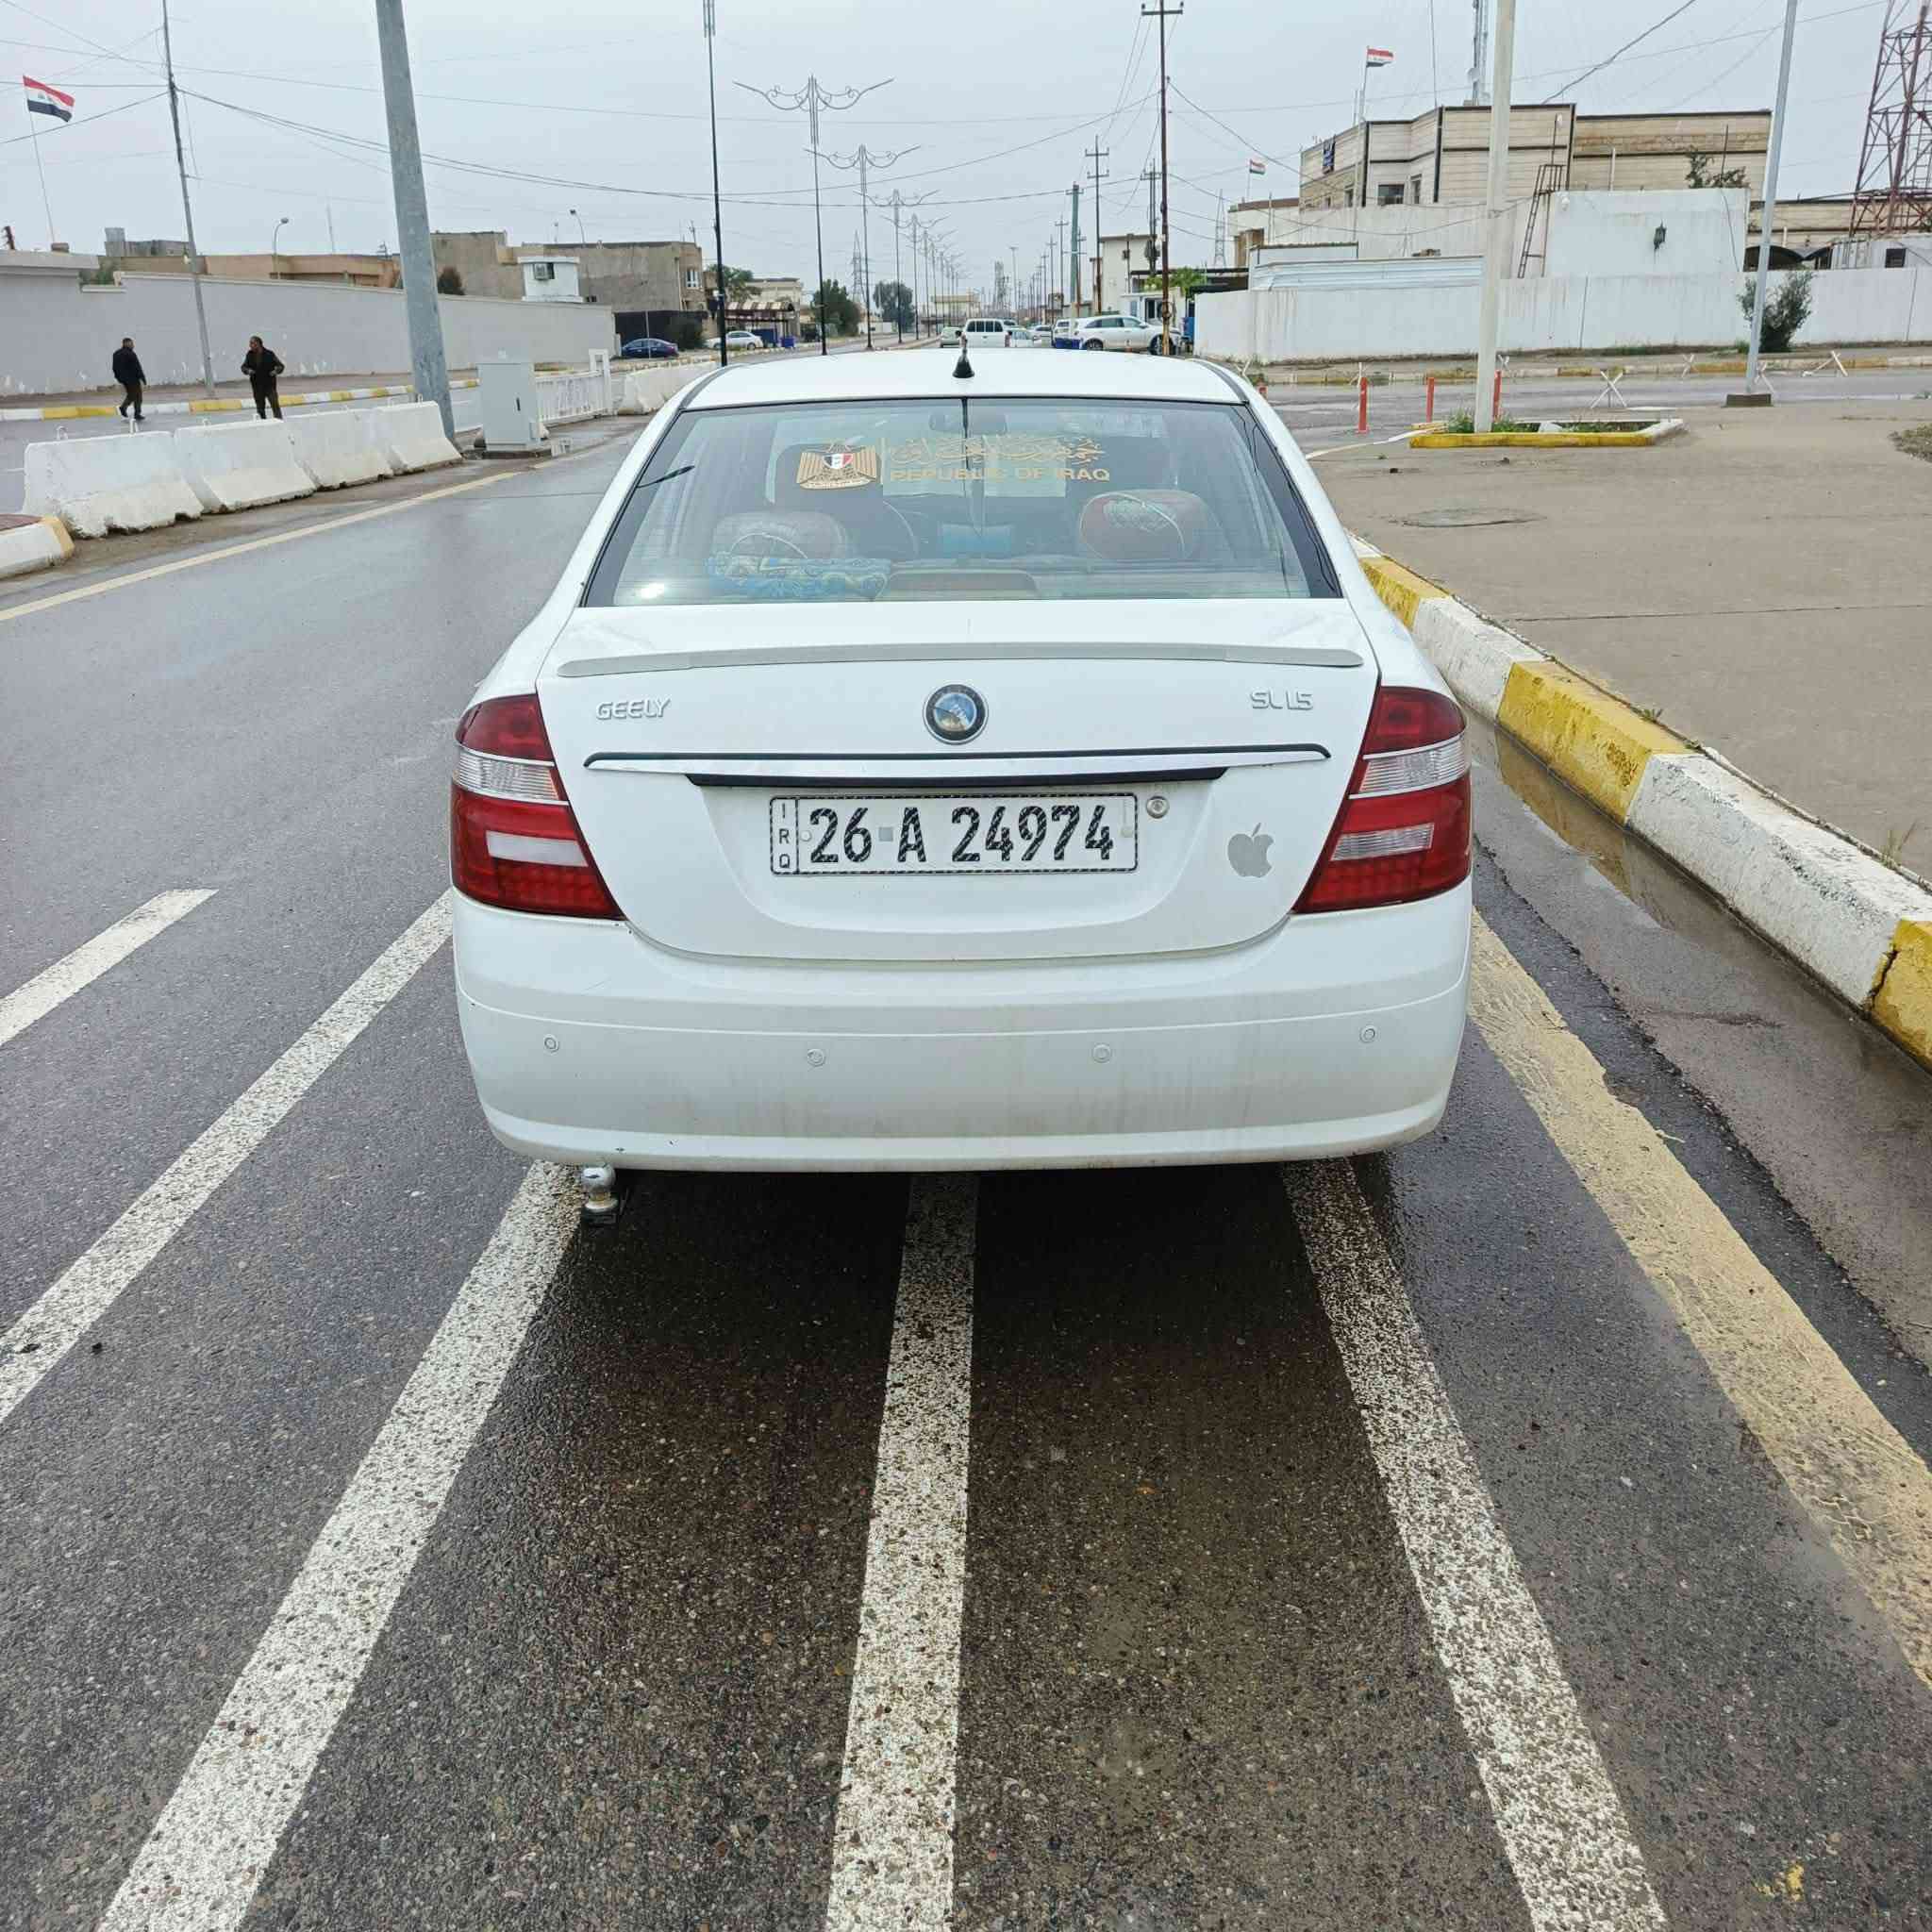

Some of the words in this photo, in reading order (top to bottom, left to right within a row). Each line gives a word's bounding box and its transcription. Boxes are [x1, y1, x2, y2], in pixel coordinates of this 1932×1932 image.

[1056, 468, 1110, 482] IRAQ
[595, 698, 672, 721] GEELY
[809, 807, 873, 863] 26
[896, 806, 927, 863] A
[951, 805, 1114, 862] 24974
